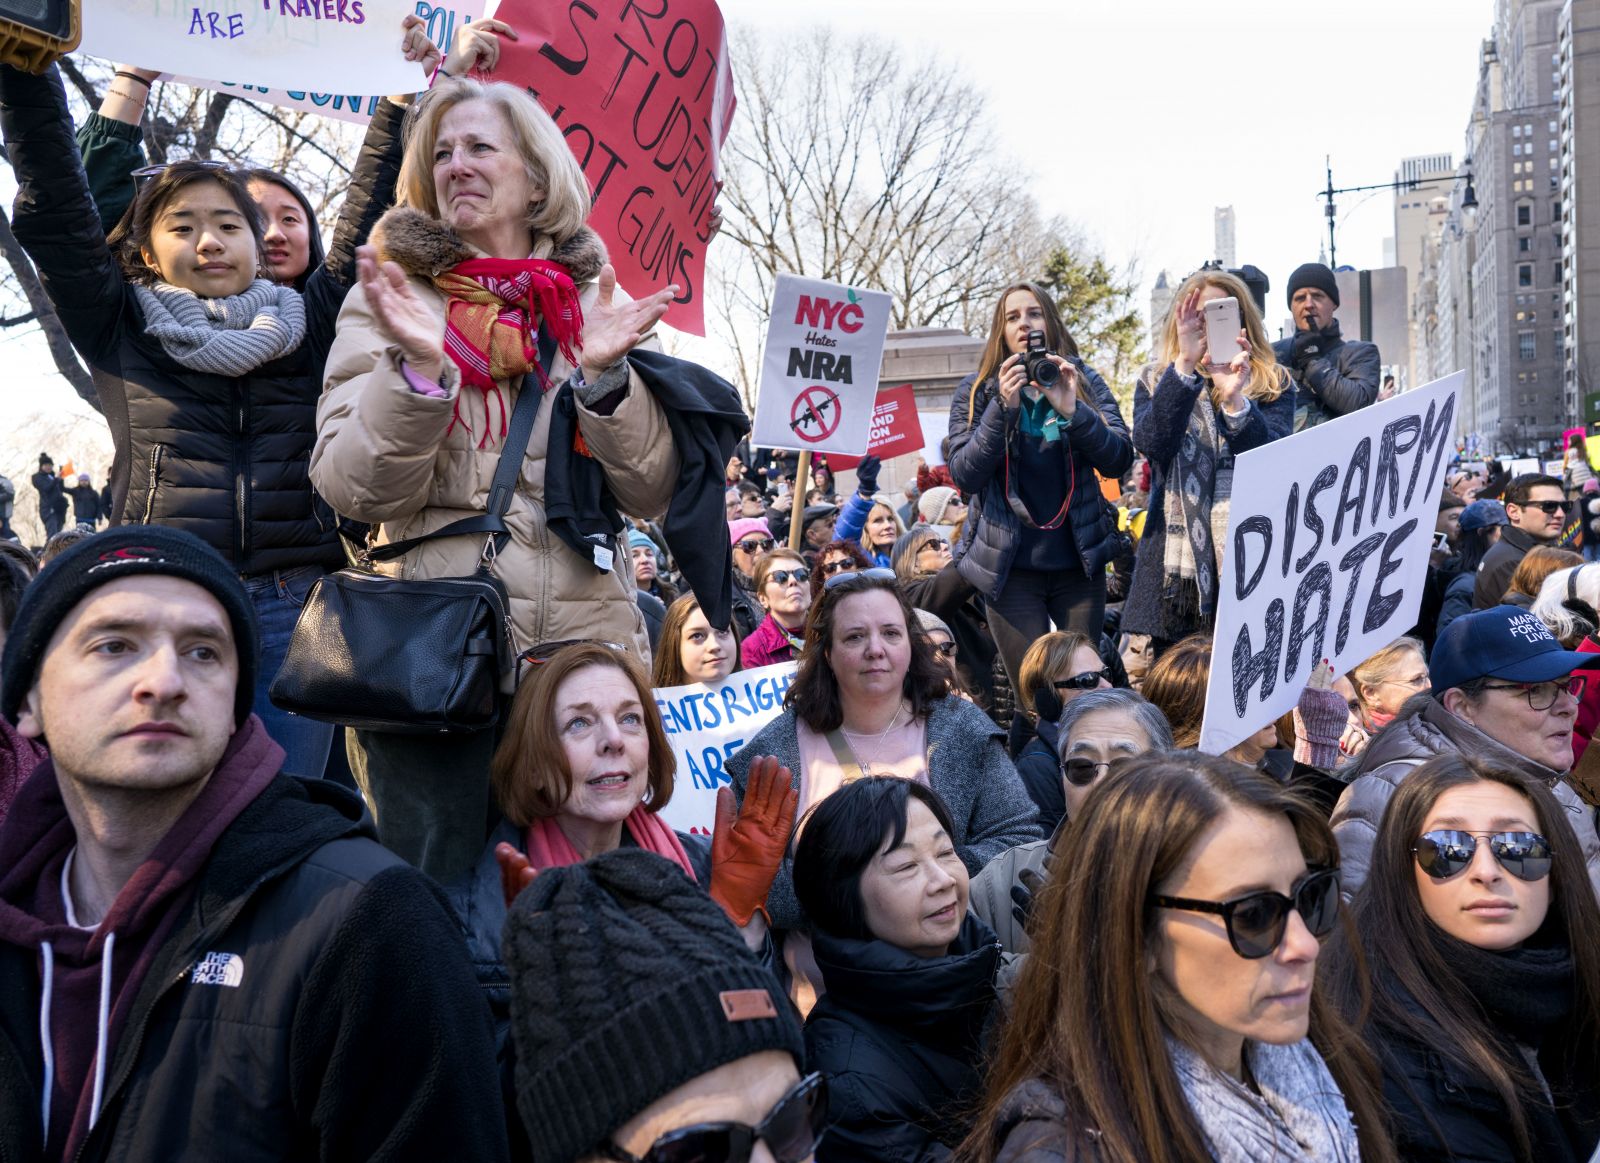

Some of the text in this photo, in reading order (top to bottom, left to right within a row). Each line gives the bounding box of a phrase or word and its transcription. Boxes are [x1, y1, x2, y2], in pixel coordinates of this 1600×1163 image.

[188, 8, 244, 39] ARE
[537, 0, 716, 244] STUDENT
[617, 186, 694, 305] GUNS
[794, 294, 864, 334] NYC
[805, 331, 837, 348] Hates
[786, 347, 853, 385] NRA
[1234, 391, 1456, 601] DISARM
[1232, 517, 1418, 718] HATE
[1509, 624, 1536, 637] FOR
[205, 951, 231, 963] THE
[191, 973, 226, 985] FACE
